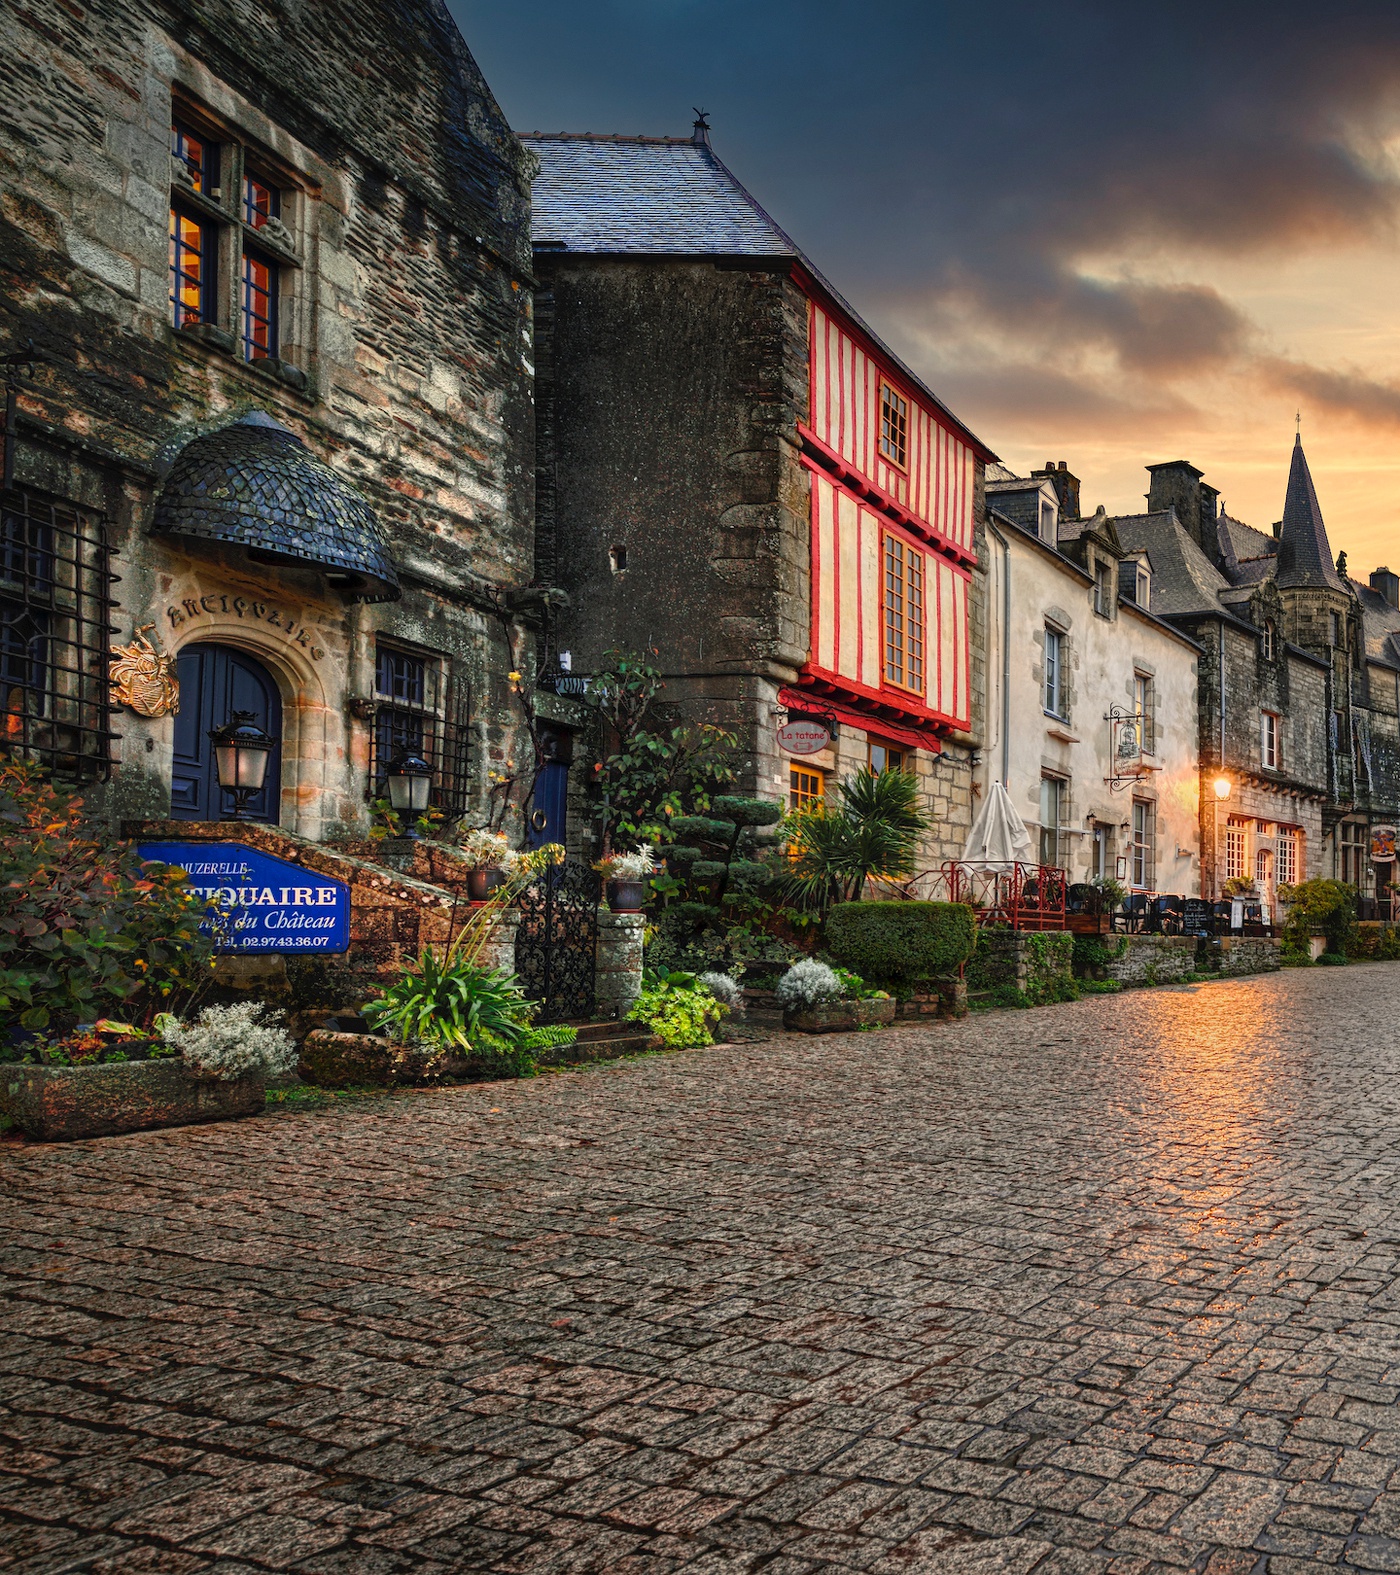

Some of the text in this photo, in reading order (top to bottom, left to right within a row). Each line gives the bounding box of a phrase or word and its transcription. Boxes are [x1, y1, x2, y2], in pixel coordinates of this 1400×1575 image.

[781, 730, 793, 739] La
[235, 910, 258, 929] du
[264, 910, 336, 929] Château
[242, 936, 330, 947] 02.97.43.36.07
